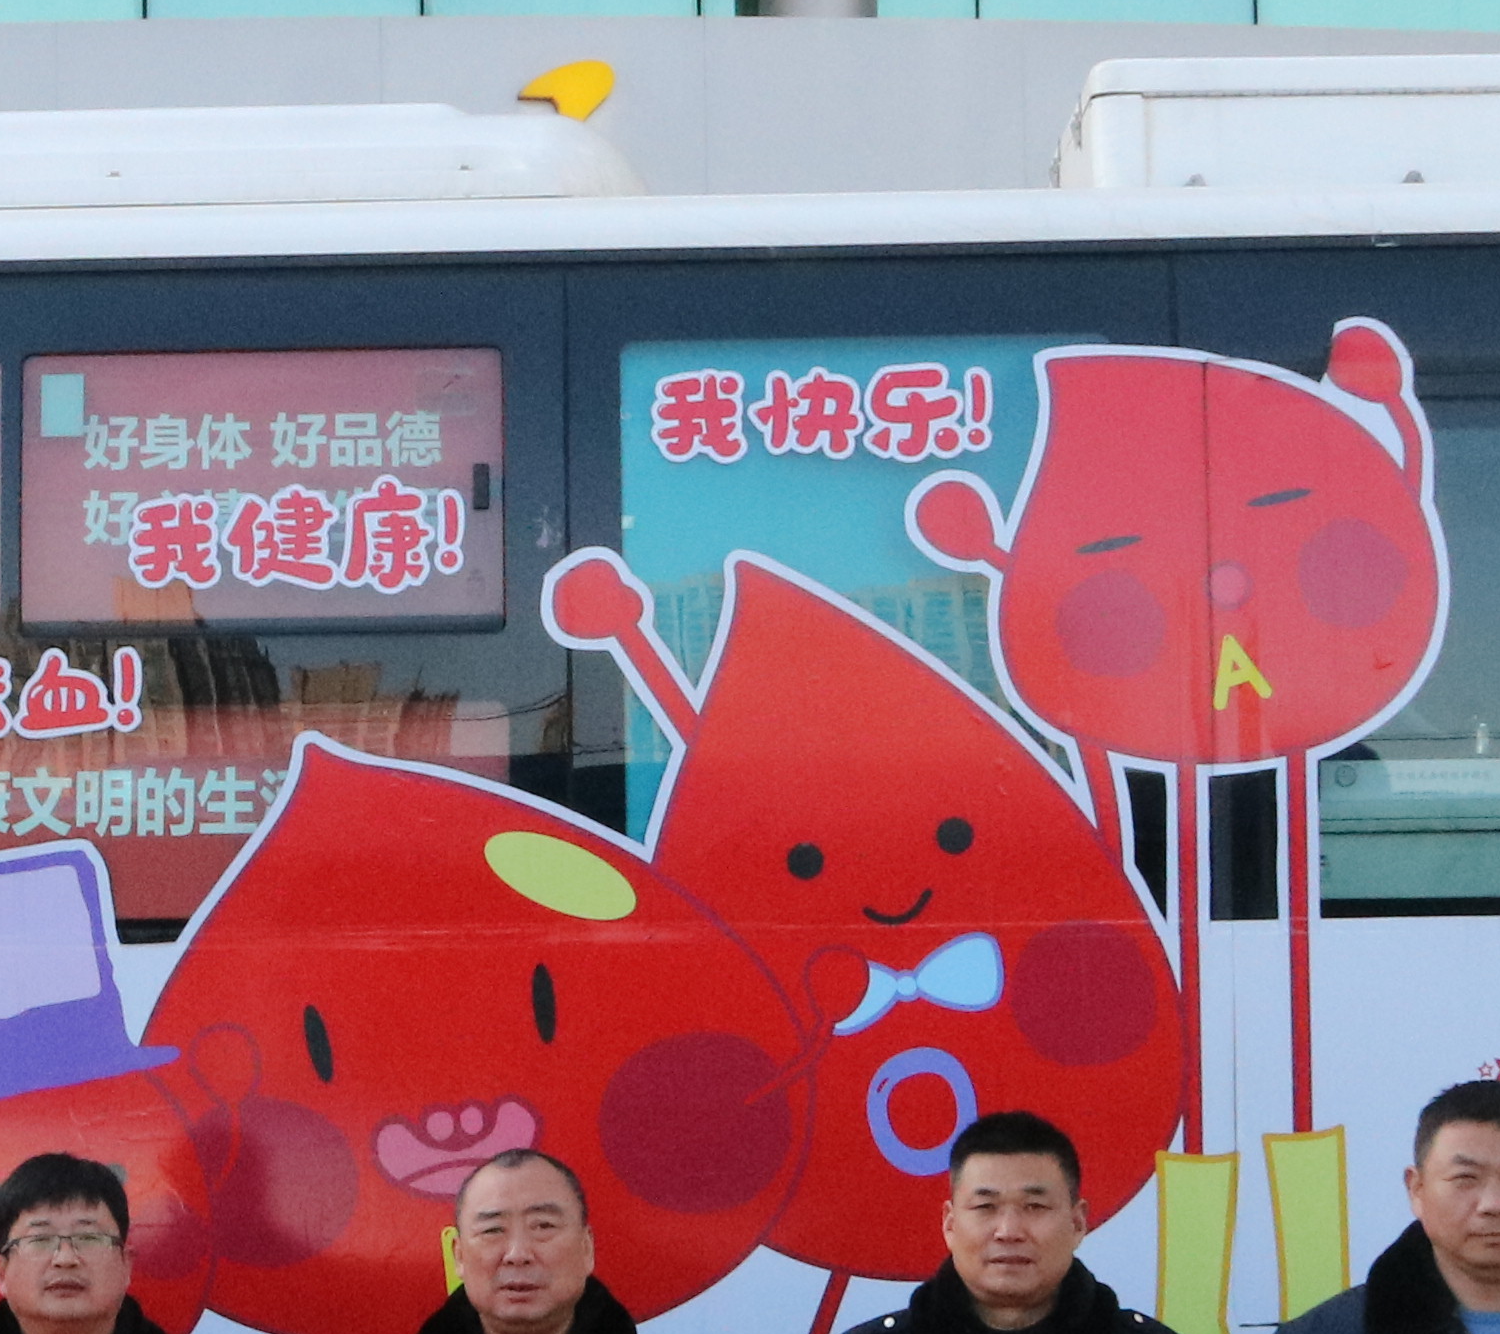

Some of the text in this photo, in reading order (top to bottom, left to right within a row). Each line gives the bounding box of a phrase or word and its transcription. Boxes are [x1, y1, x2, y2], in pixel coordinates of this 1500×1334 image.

[83, 410, 443, 471] 好身体 好品德
[1213, 635, 1272, 710] A
